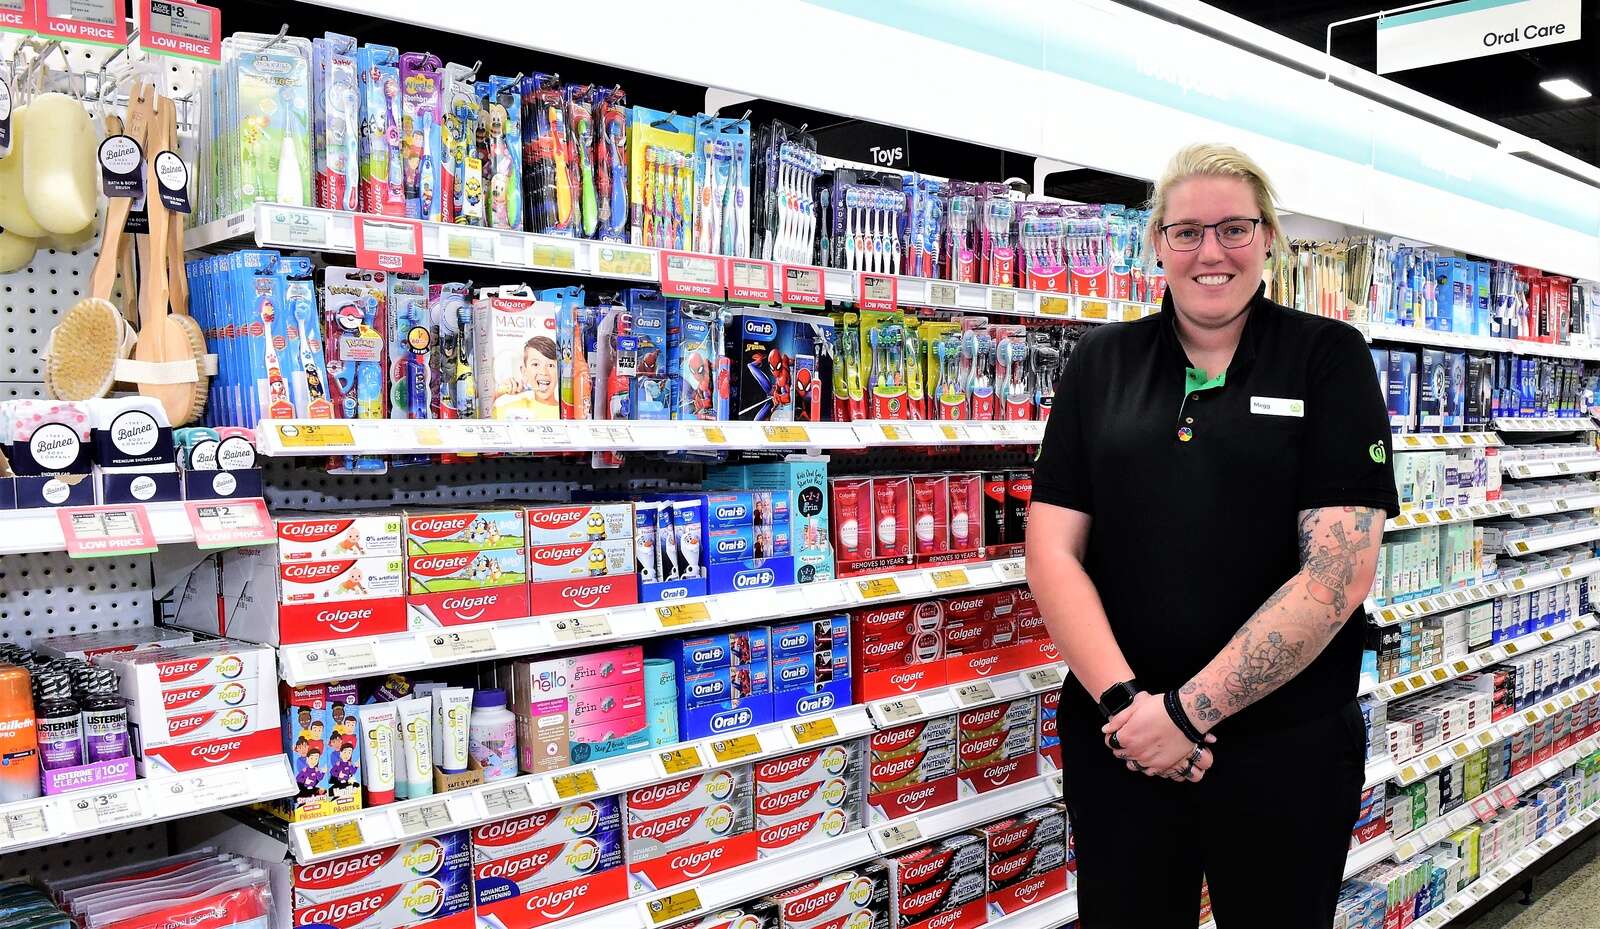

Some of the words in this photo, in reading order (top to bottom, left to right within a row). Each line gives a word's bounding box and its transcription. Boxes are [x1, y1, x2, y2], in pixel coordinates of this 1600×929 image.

[49, 22, 77, 34] LOW
[79, 26, 115, 39] PRICE
[1482, 30, 1520, 48] Oral
[1524, 22, 1566, 41] Care
[151, 36, 177, 48] LOW
[179, 41, 211, 55] PRICE
[105, 147, 136, 160] Balnea
[870, 146, 903, 166] Toys
[675, 285, 691, 293] LOW
[692, 286, 712, 295] PRICE
[734, 290, 749, 298] LOW
[750, 291, 769, 300] PRICE
[493, 300, 527, 309] Colgate
[787, 294, 802, 302] LOW
[803, 295, 820, 304] PRICE
[877, 303, 893, 311] PRICE
[495, 316, 537, 329] MAGIK
[637, 318, 661, 328] Oral-B
[687, 324, 705, 333] Oral-B
[746, 322, 774, 335] Oral-B
[619, 361, 635, 369] WARS
[1253, 401, 1271, 410] Megg
[117, 423, 153, 441] Balnea
[37, 437, 74, 454] Balnea
[222, 449, 251, 460] Balnea
[719, 507, 745, 517] Oral-B
[803, 502, 818, 513] grin
[533, 511, 582, 524] Colgate
[282, 524, 338, 536] Colgate
[411, 519, 466, 532] Colgate
[79, 540, 106, 549] LOW
[109, 537, 144, 548] PRICE
[719, 541, 746, 550] Oral-B
[535, 547, 583, 559] Colgate
[929, 554, 953, 562] REMOVES
[413, 557, 468, 570] Colgate
[852, 561, 878, 569] REMOVES
[285, 565, 340, 577] Colgate
[737, 573, 772, 587] Oral-B
[562, 584, 612, 598] Colgate
[442, 595, 498, 610] Colgate
[949, 599, 984, 611] Colgate
[317, 609, 372, 622] Colgate
[866, 610, 906, 624] Colgate
[948, 626, 982, 640] Colgate
[782, 637, 808, 647] Oral-B
[865, 641, 905, 655] Colgate
[694, 649, 723, 661] Oral-B
[160, 661, 198, 676] lgate
[969, 655, 999, 669] Colgate
[574, 668, 597, 681] grin
[783, 668, 808, 679] Oral-B
[890, 671, 925, 685] Colgate
[328, 684, 356, 694] Toothpaste
[531, 672, 567, 693] hello
[695, 684, 723, 694] Oral-B
[164, 690, 201, 704] lgate
[295, 689, 323, 698] Toothpaste
[800, 697, 833, 711] Oral-B
[1010, 703, 1028, 712] ADVANCED
[575, 705, 597, 717] grin
[962, 708, 1000, 725] Colgate
[1005, 708, 1032, 719] WHITENING
[38, 720, 78, 731] LISTERINE
[168, 717, 203, 731] lgate
[714, 713, 751, 730] Oral-B
[928, 723, 947, 732] ADVANCED
[873, 728, 916, 746] Colgate
[922, 727, 950, 740] WHITENING
[1009, 731, 1027, 740] ADVANCED
[191, 741, 242, 757] Colgate
[961, 737, 999, 754] Colgate
[1005, 737, 1030, 749] WHITENING
[927, 752, 946, 761] ADVANCED
[760, 757, 811, 777] Colgate
[873, 757, 915, 776] Colgate
[921, 757, 950, 771] WHITENING
[984, 761, 1018, 778] Colgate
[53, 769, 93, 780] LISTERINE
[54, 777, 93, 787] CLEANS
[632, 781, 692, 803] Colgate
[897, 787, 934, 805] Colgate
[760, 789, 810, 810] Colgate
[563, 815, 590, 827] Total
[600, 813, 620, 822] ADVANCED
[478, 814, 547, 840] Colgate
[632, 817, 692, 839] Colgate
[761, 821, 810, 843] Colgate
[1038, 822, 1063, 835] WHITENING
[993, 827, 1030, 848] Colgate
[402, 854, 435, 868] Total
[446, 851, 469, 861] ADVANCED
[565, 852, 592, 865] Total
[601, 850, 621, 859] ADVANCED
[671, 847, 724, 869] Colgate
[955, 851, 984, 866] WHITENING
[1036, 850, 1062, 865] WHITENING
[301, 851, 383, 882] Colgate
[445, 857, 469, 868] WHITENING
[480, 853, 548, 879] Colgate
[904, 858, 945, 880] Colgate
[992, 856, 1027, 877] Colgate
[480, 884, 509, 897] ADVANCED
[849, 888, 868, 902] Total
[954, 882, 983, 898] WHITENING
[1014, 880, 1045, 898] Colgate
[402, 895, 435, 908] Total
[446, 891, 469, 902] ADVANCED
[480, 891, 511, 903] WHITENING
[527, 886, 588, 910] Colgate
[902, 888, 943, 910] Colgate
[445, 898, 469, 909] WHITENING
[788, 890, 837, 917] Colgate
[302, 896, 383, 926] Colgate
[928, 910, 962, 929] Colgate
